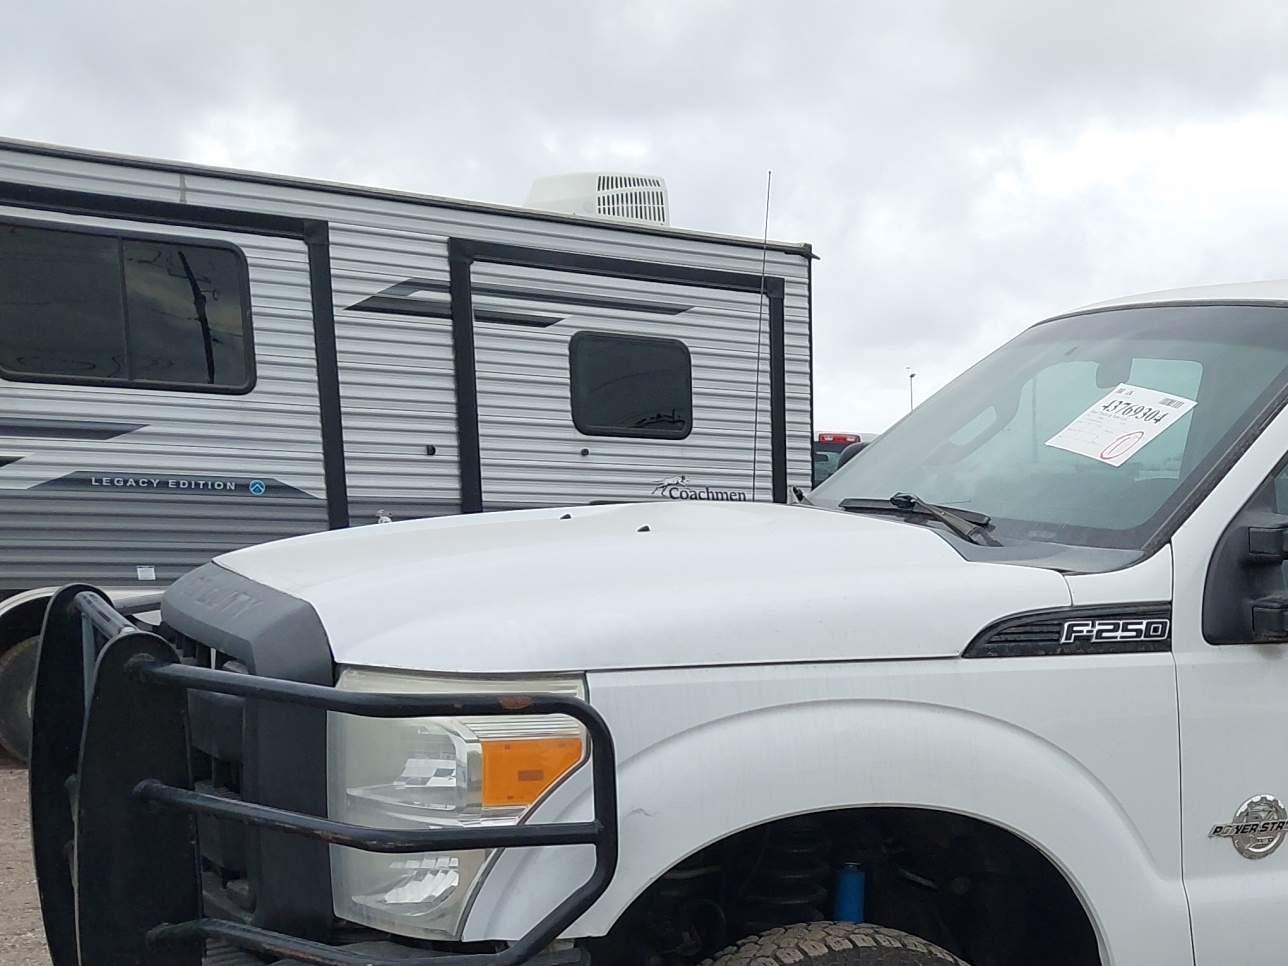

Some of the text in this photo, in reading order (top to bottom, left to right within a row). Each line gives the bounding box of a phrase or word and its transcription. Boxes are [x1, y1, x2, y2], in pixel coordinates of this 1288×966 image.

[1102, 399, 1169, 424] 43769304
[91, 477, 236, 490] LEGACY EDITION
[668, 486, 747, 501] Coachmen
[1060, 619, 1170, 644] F-250
